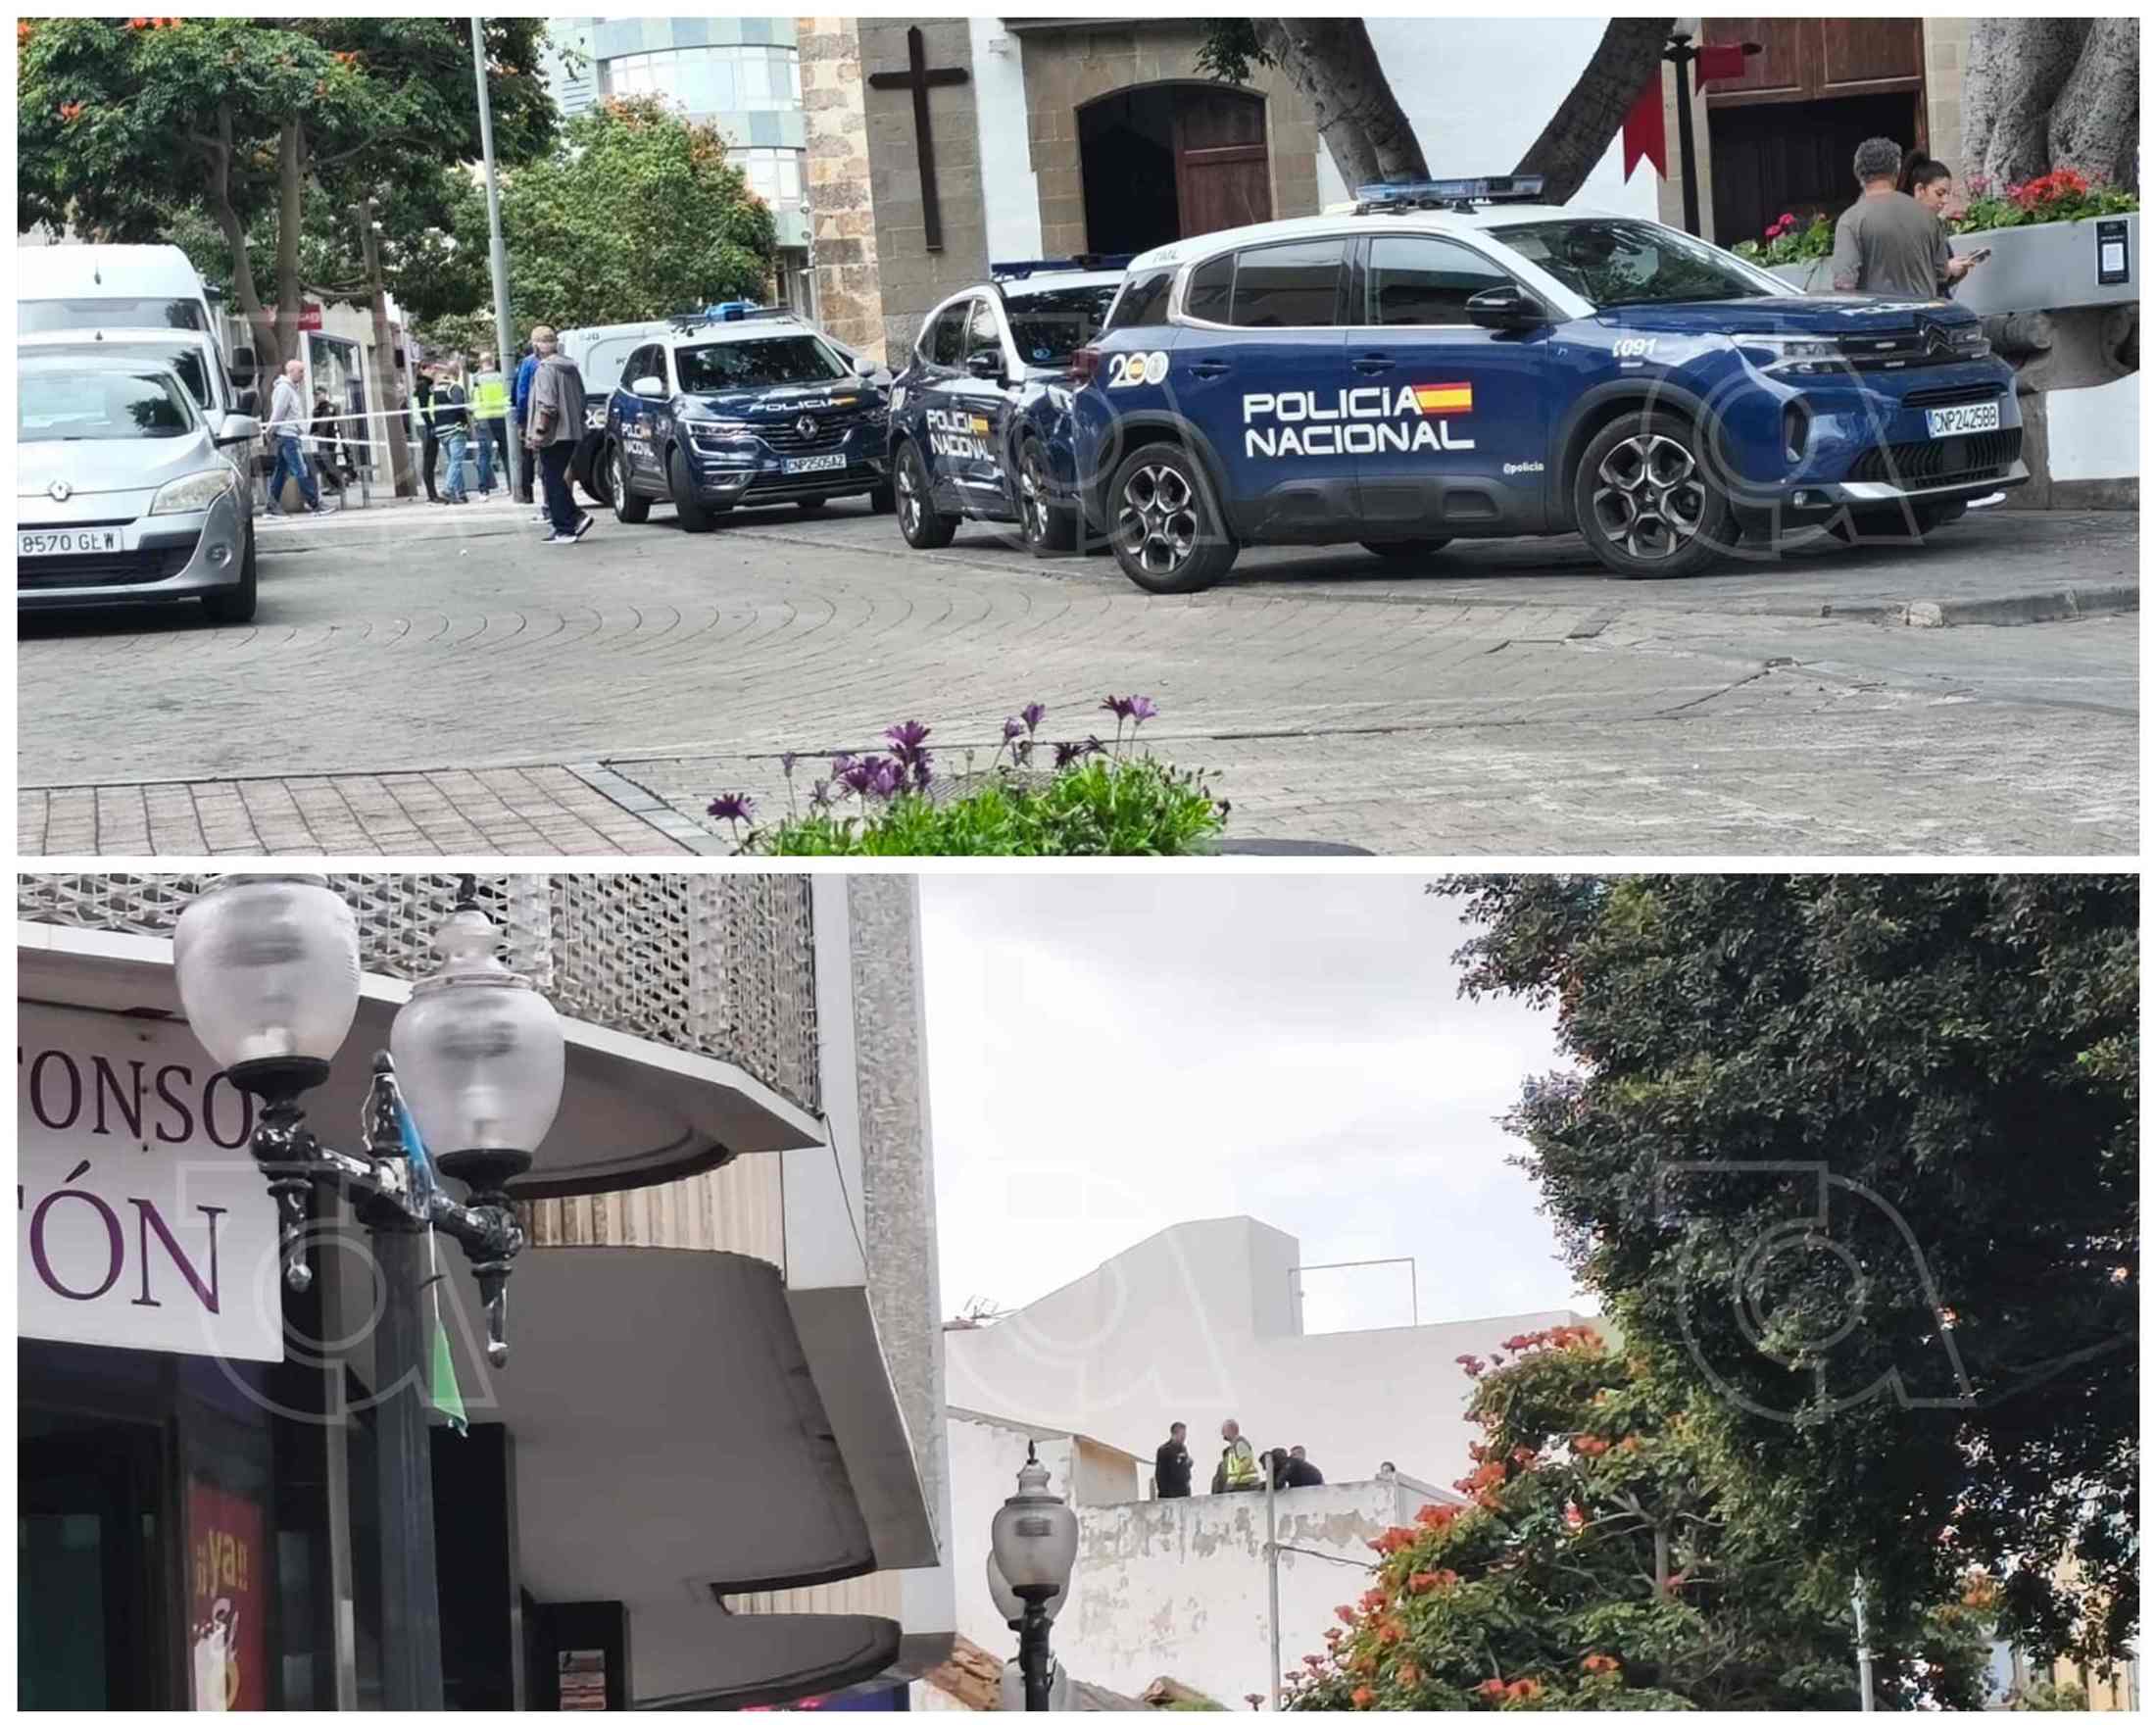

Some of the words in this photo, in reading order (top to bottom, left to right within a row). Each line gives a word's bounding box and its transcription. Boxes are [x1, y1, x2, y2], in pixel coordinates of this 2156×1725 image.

[1107, 351, 1169, 388] 200
[929, 432, 996, 462] NACIONAL
[1245, 419, 1475, 458] NACIONAL
[1503, 461, 1544, 475] @policia
[23, 534, 72, 553] 8570
[78, 532, 115, 551] GLW
[18, 1046, 254, 1150] ONSO
[18, 1159, 227, 1314] ÓN
